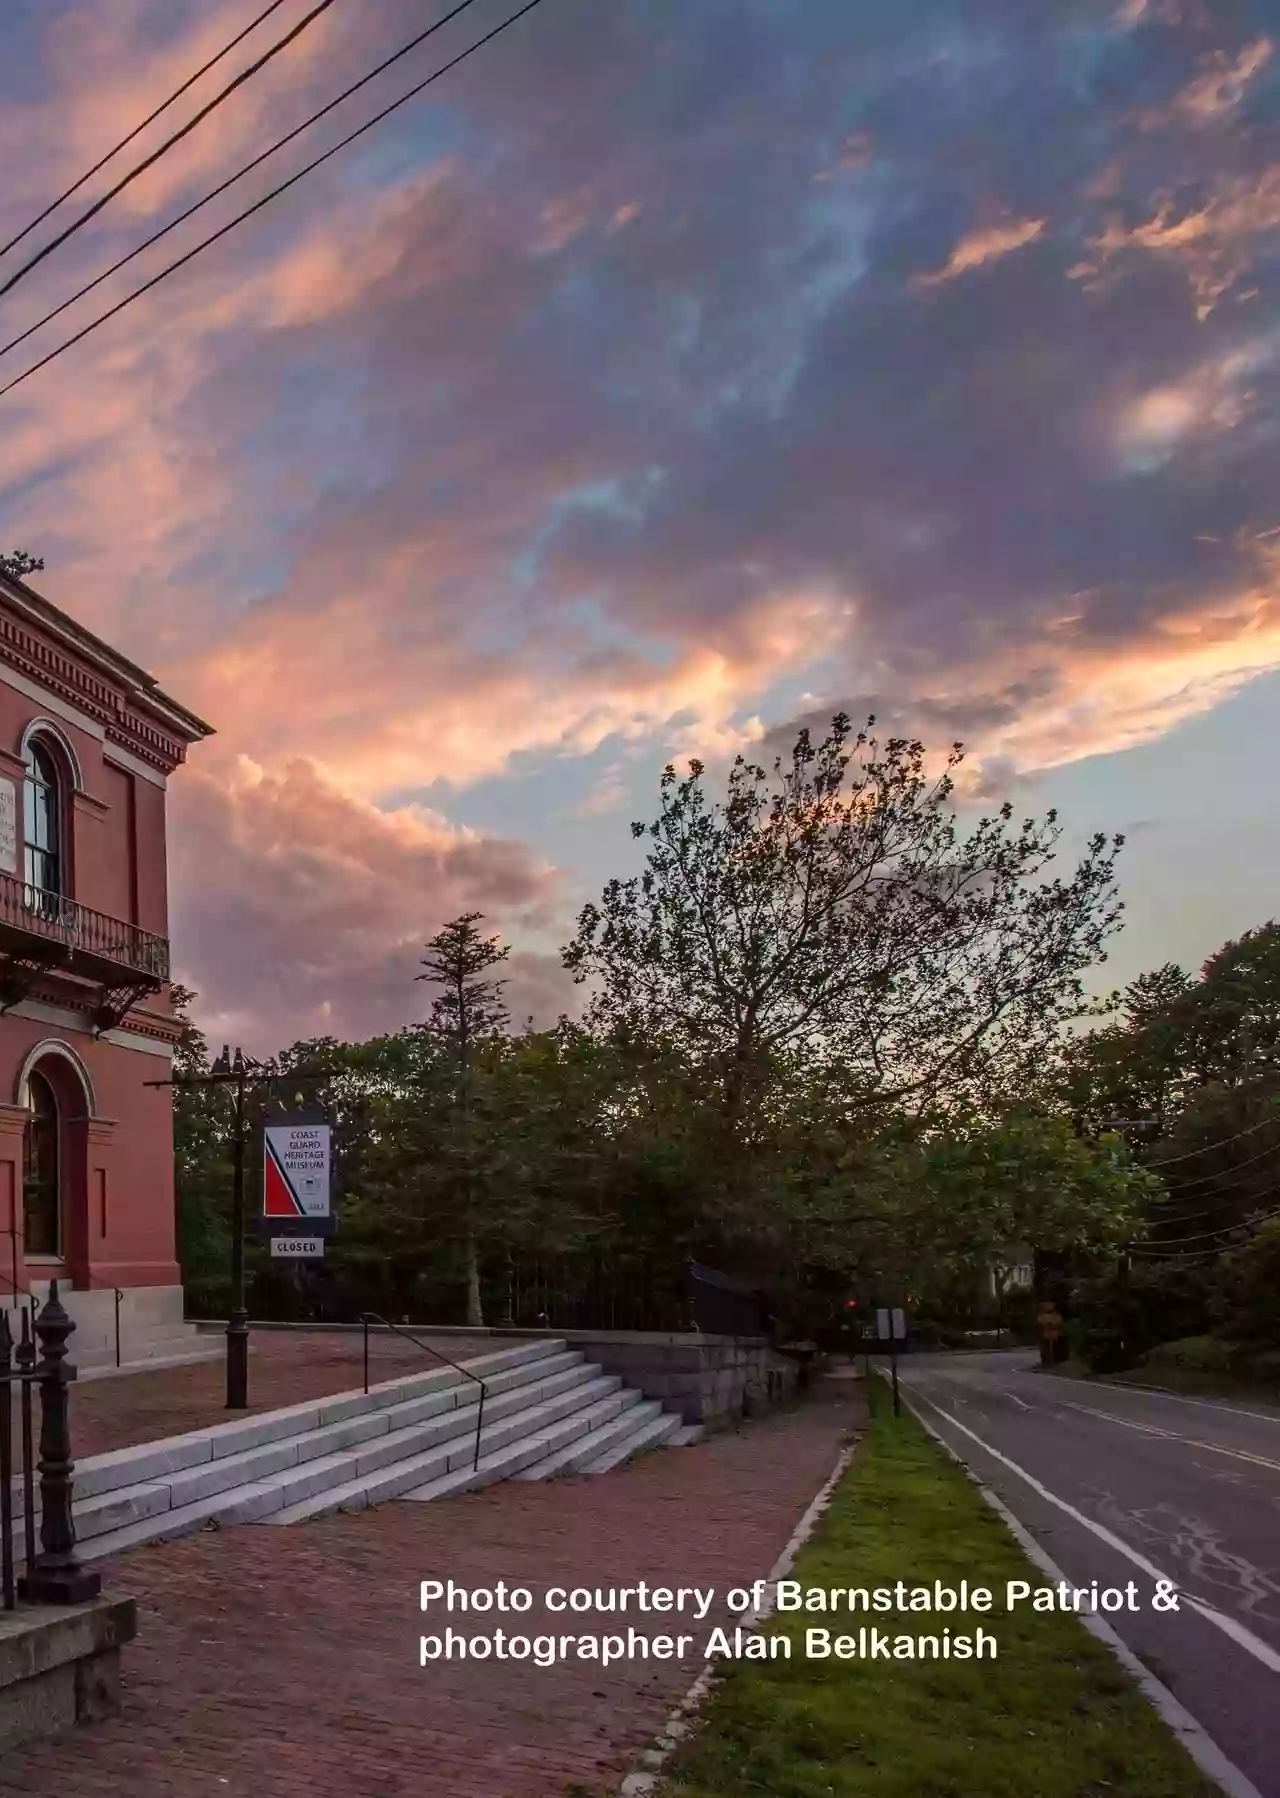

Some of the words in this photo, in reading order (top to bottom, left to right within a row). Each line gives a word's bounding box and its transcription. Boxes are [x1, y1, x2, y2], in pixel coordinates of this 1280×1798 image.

[291, 1131, 319, 1140] COAST
[289, 1142, 321, 1150] GUARD
[284, 1151, 325, 1160] HERITAGE
[285, 1161, 325, 1170] MUSEUM
[277, 1243, 316, 1252] CLOSED
